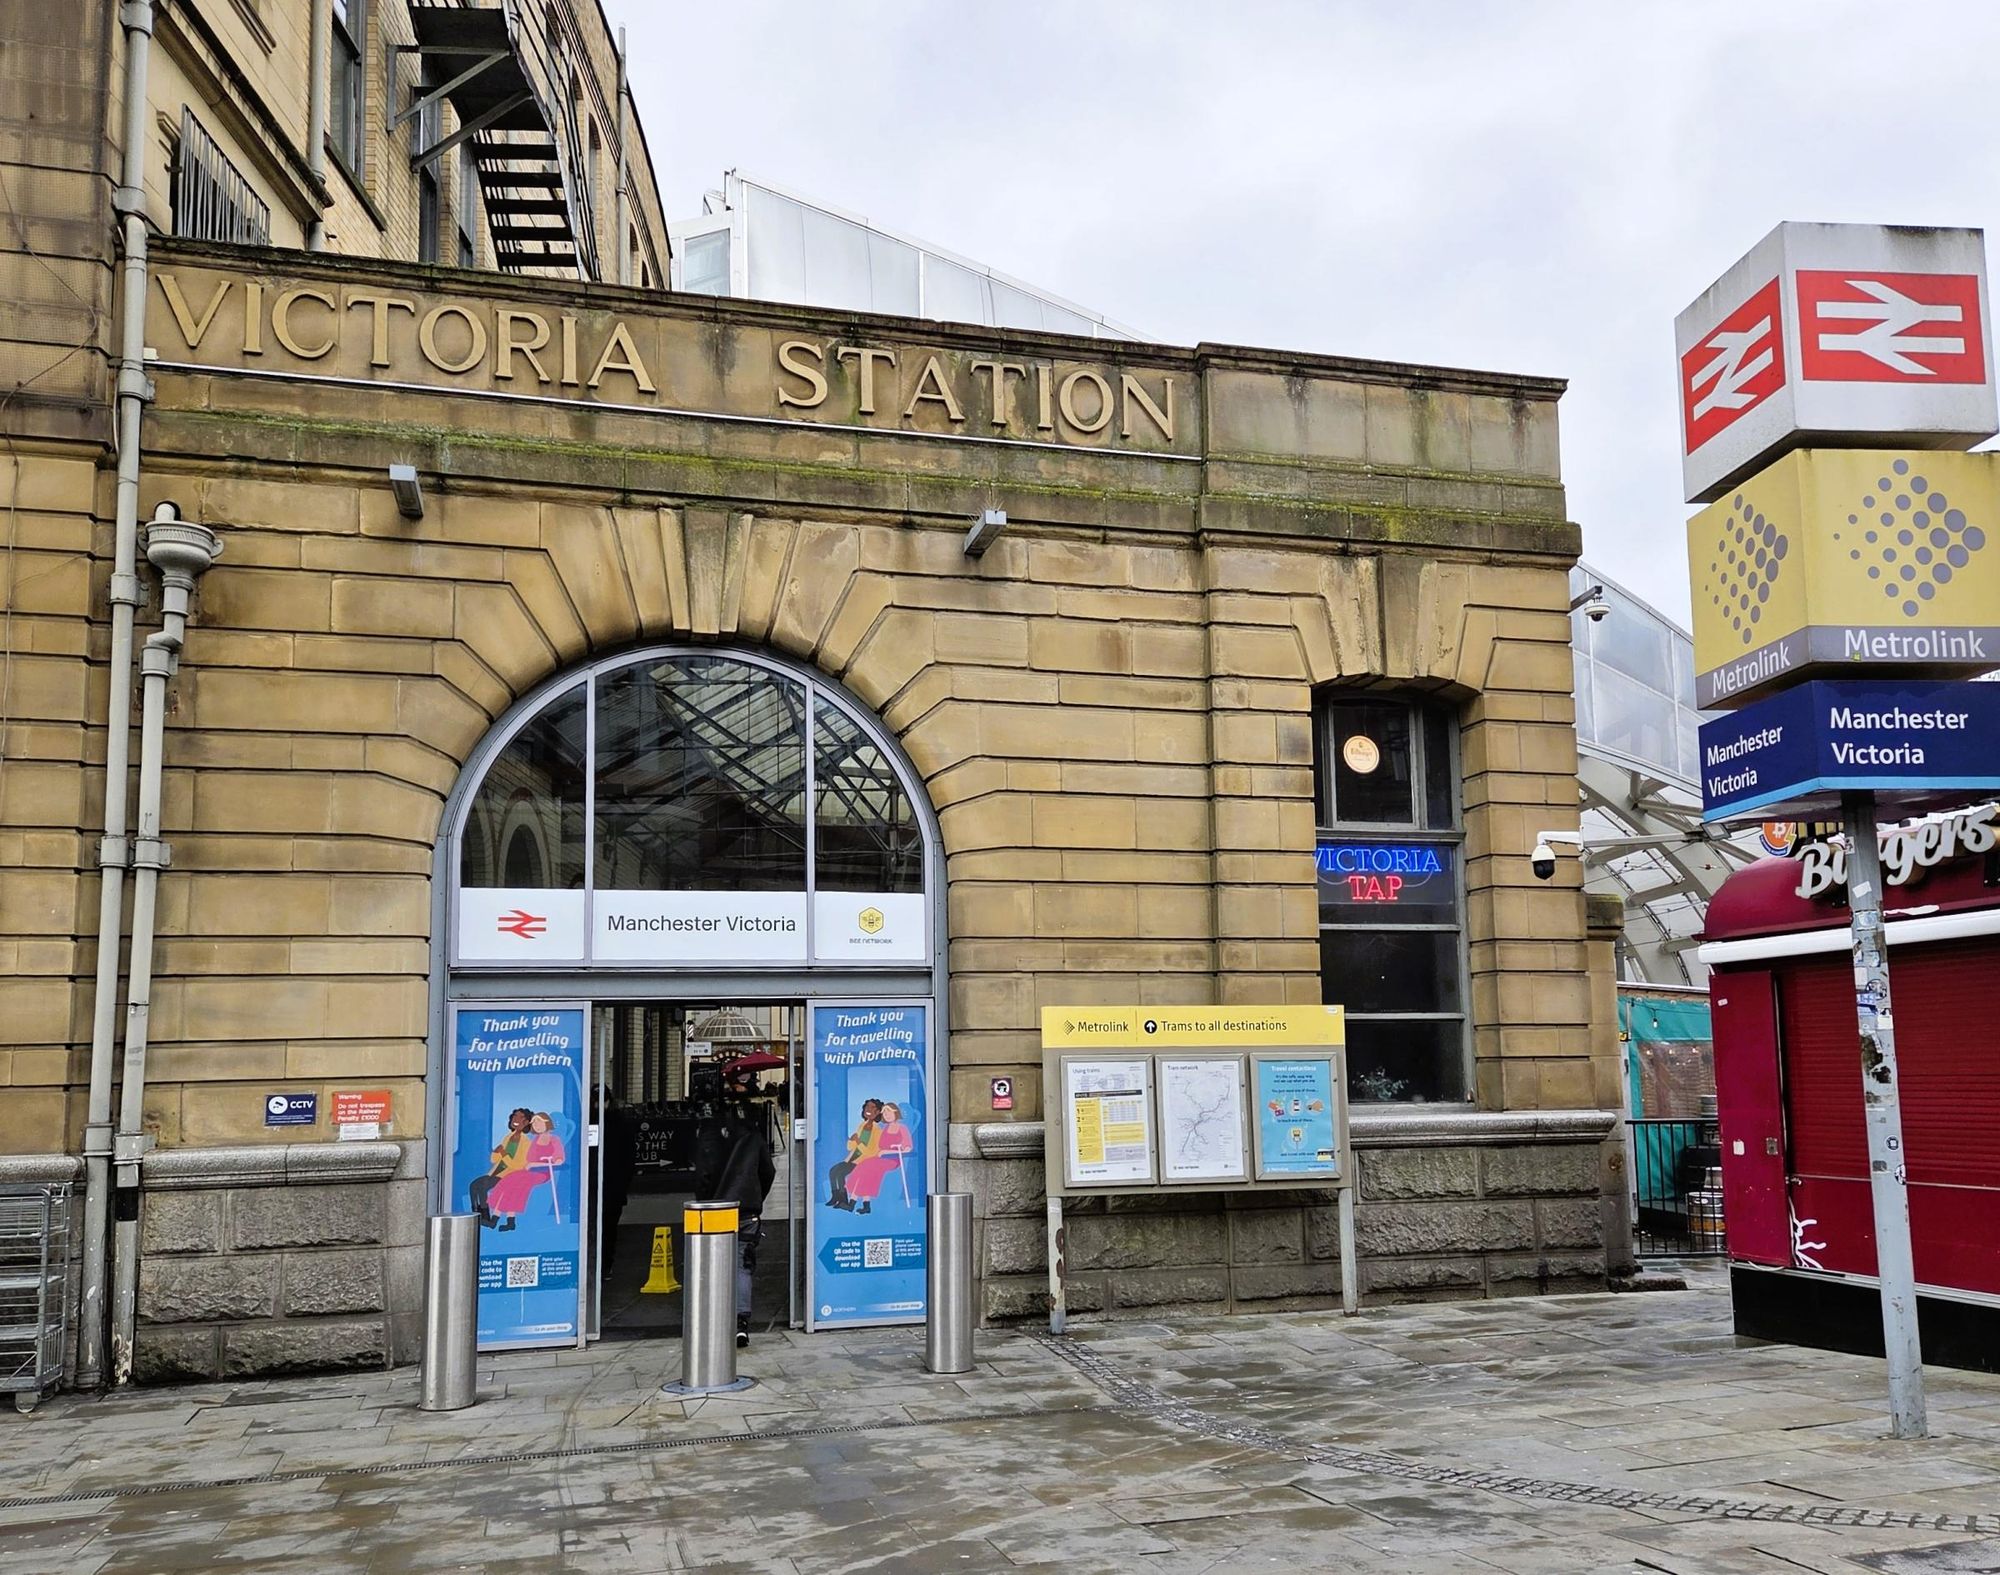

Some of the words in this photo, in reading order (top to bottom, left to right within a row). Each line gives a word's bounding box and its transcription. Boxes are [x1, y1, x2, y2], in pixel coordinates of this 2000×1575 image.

[156, 274, 657, 394] VICTORIA
[777, 341, 1174, 441] STATION
[1844, 629, 1986, 658] Metrolink
[1712, 642, 1791, 699] Metrolink
[1830, 706, 1969, 729] Manchester
[1707, 725, 1783, 767] Manchester
[1831, 742, 1925, 765] Victoria
[1708, 768, 1758, 798] Victoria
[1795, 806, 1997, 899] Bugers
[1348, 875, 1403, 900] TAP
[607, 915, 721, 931] Manchester
[726, 916, 796, 931] Victoria
[483, 1015, 528, 1032] Thank
[532, 1015, 559, 1030] you
[836, 1011, 876, 1027] Thank
[880, 1011, 904, 1025] you
[1077, 1021, 1129, 1033] Metrolink
[1161, 1020, 1192, 1031] Trams
[1195, 1021, 1206, 1031] to
[1208, 1020, 1221, 1031] all
[1223, 1019, 1287, 1031] destinations
[468, 1038, 494, 1053] for
[496, 1032, 569, 1049] travelling
[825, 1032, 847, 1047] for
[849, 1027, 913, 1043] travelling
[467, 1058, 502, 1072] with
[505, 1052, 572, 1070] Northern
[824, 1052, 854, 1065] with
[857, 1046, 916, 1063] Northern
[290, 1100, 313, 1109] CCTV
[645, 1140, 667, 1150] THE
[648, 1130, 674, 1140] WAY
